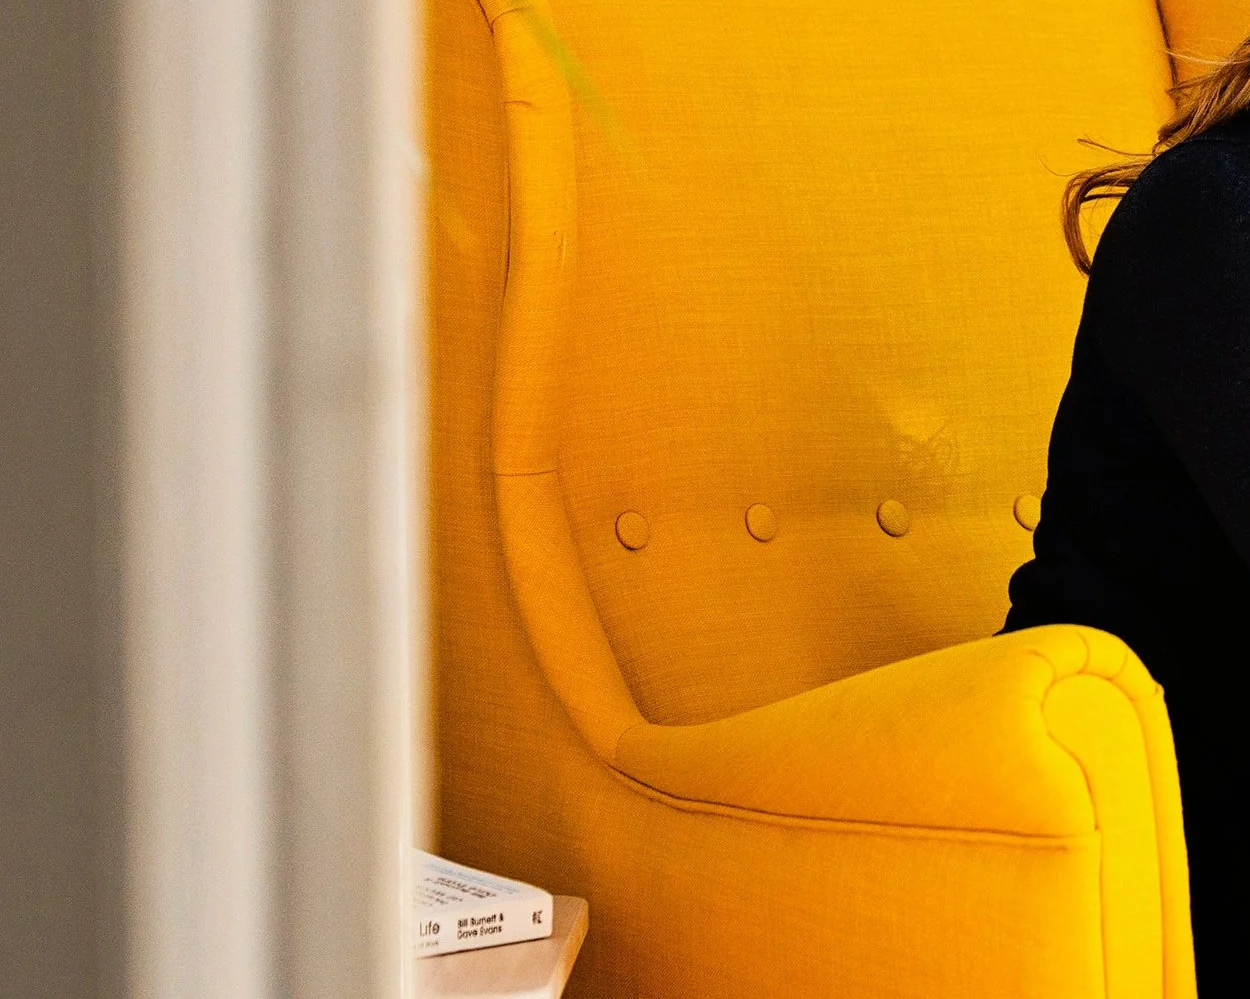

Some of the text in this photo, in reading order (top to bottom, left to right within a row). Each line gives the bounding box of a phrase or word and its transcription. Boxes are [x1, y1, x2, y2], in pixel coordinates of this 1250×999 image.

[419, 920, 440, 937] Life
[457, 918, 468, 929] Bill
[471, 915, 497, 926] Burnett
[457, 925, 502, 940] Dave Evans
